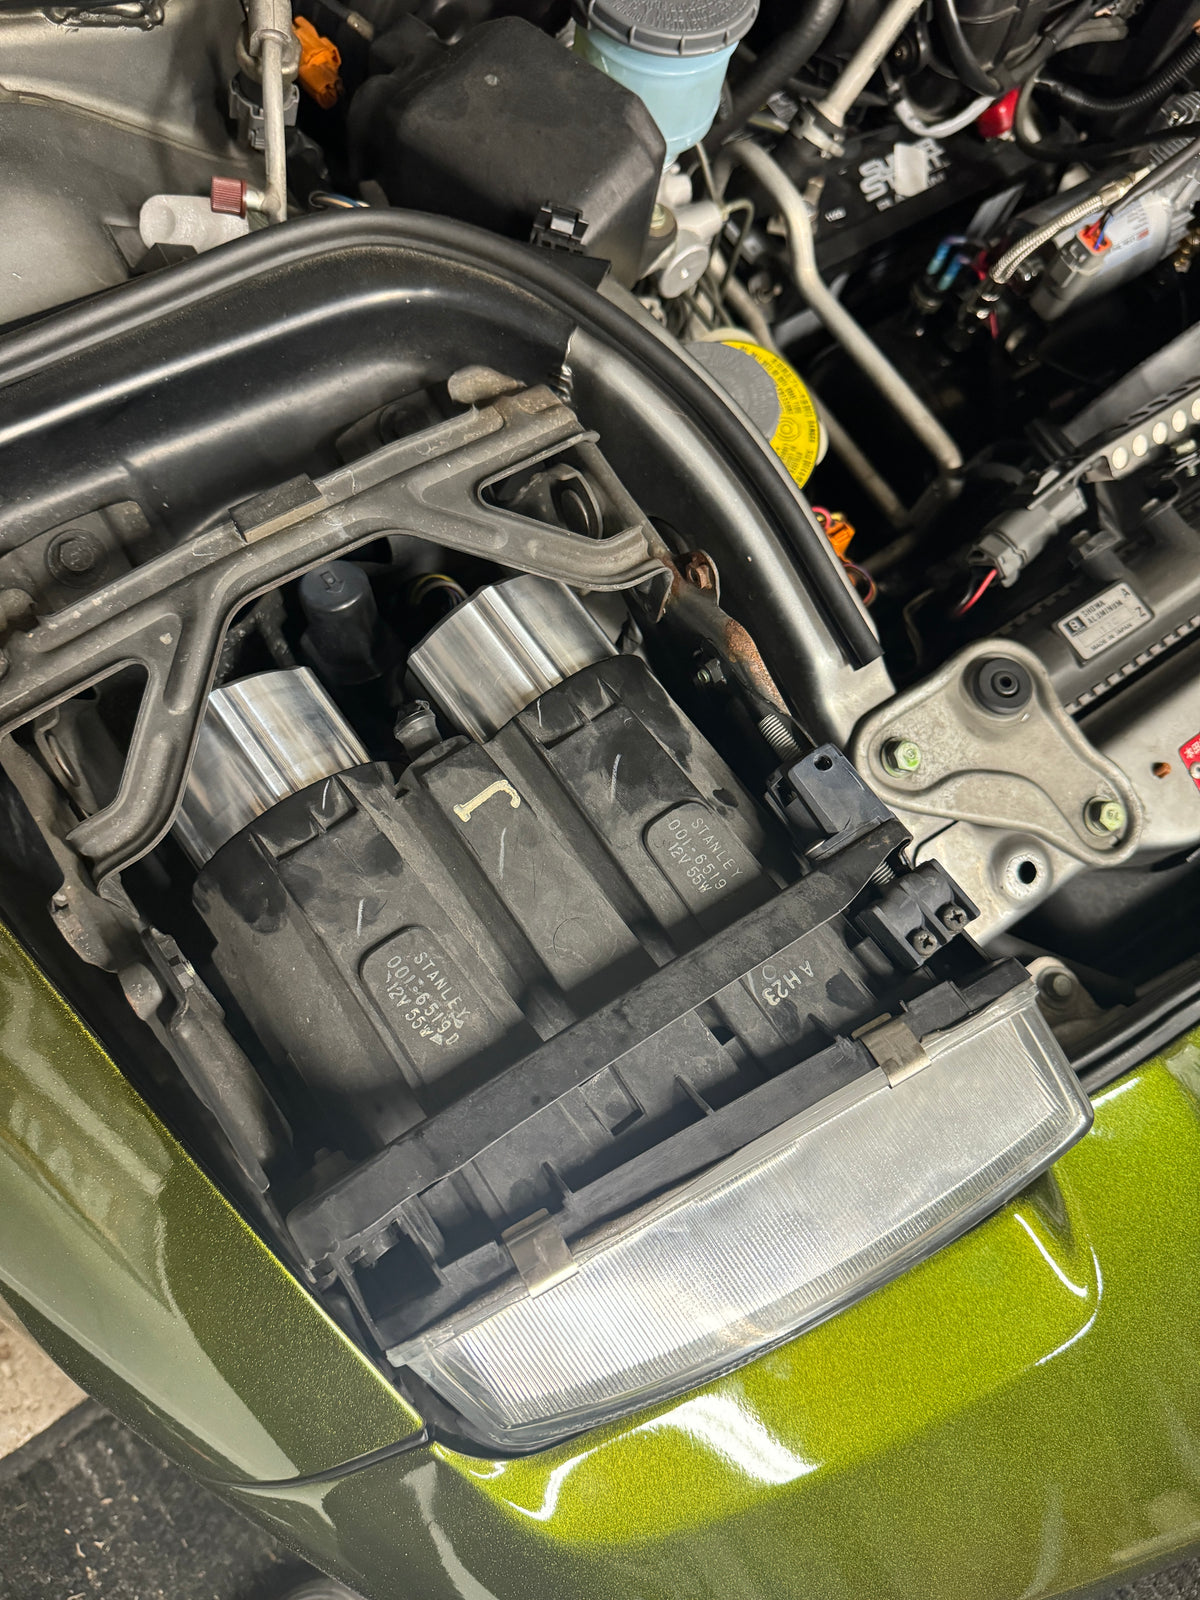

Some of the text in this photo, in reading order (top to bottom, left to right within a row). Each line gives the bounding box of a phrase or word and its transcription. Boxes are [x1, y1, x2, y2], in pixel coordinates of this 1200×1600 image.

[1081, 599, 1106, 618] SHOWA
[1087, 599, 1124, 624] ALUMINUM
[1115, 622, 1133, 636] JAPAN
[668, 842, 713, 893] 12V 55W
[691, 817, 743, 878] STANLEY
[387, 982, 434, 1038] 12V 55W
[414, 951, 470, 1019] STANLEY
